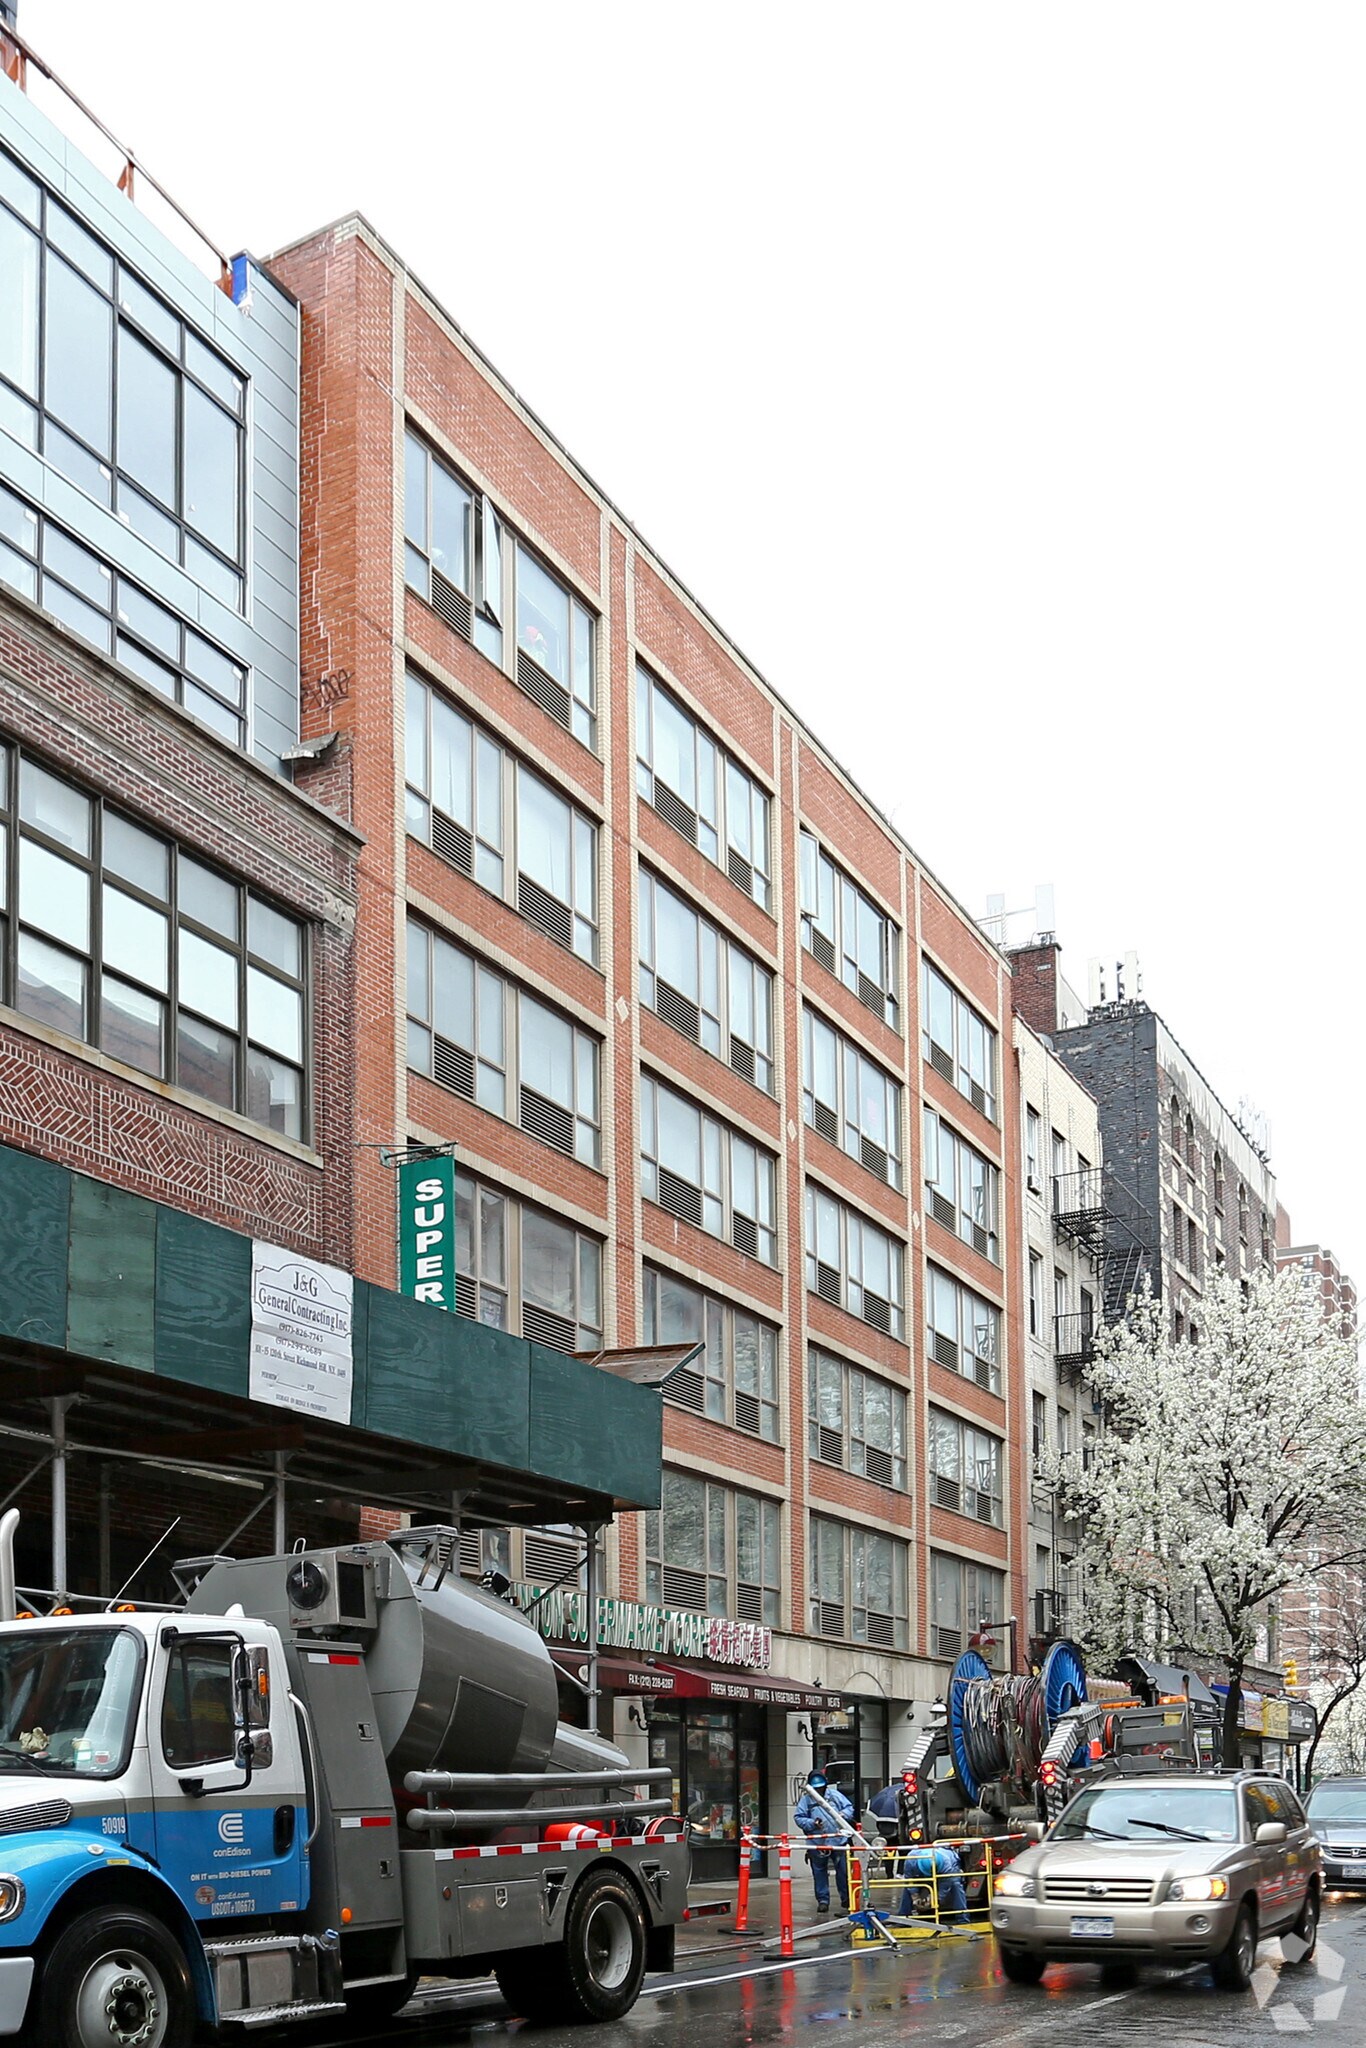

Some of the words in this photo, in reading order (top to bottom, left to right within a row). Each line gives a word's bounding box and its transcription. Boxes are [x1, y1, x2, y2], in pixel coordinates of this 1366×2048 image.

[415, 1178, 448, 1311] SUPER
[293, 1271, 318, 1297] J&G
[258, 1287, 291, 1315] General
[291, 1298, 335, 1332] Contracting
[335, 1312, 349, 1332] Inc.
[564, 1592, 671, 1655] SUERMARKET
[672, 1611, 706, 1659] CORP
[710, 1682, 727, 1696] FRESH
[727, 1684, 749, 1699] SEAFOOD
[754, 1688, 770, 1702] FRUITS
[775, 1691, 801, 1704] VEGETABLES
[805, 1694, 823, 1707] POULTRY
[827, 1696, 841, 1708] MEATS
[102, 1816, 126, 1834] 50919
[213, 1847, 251, 1857] conEdison
[190, 1874, 200, 1882] ON
[219, 1870, 251, 1880] BIO-DIESEL
[251, 1868, 271, 1877] POWER
[218, 1891, 250, 1901] conEd.com
